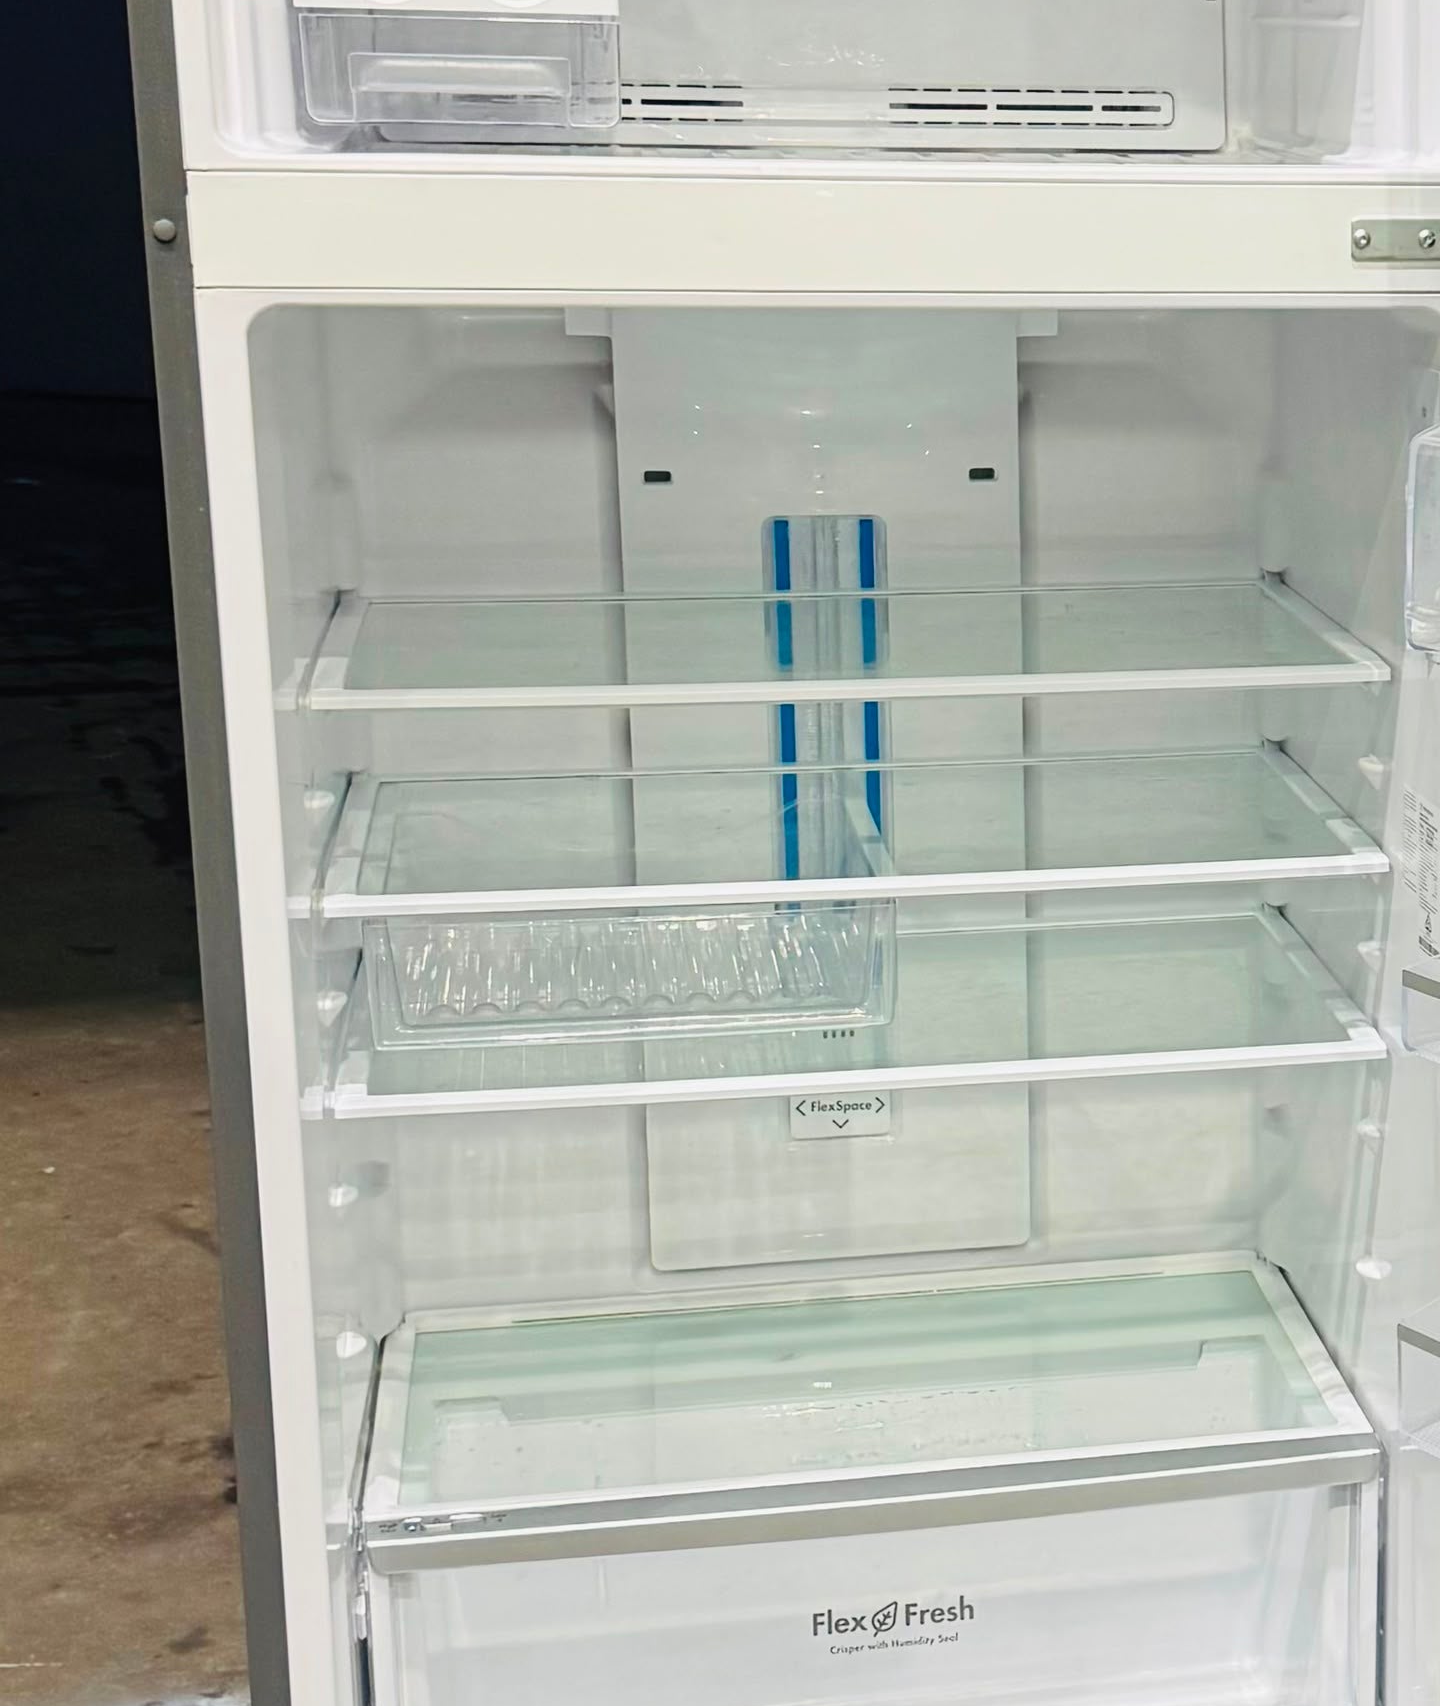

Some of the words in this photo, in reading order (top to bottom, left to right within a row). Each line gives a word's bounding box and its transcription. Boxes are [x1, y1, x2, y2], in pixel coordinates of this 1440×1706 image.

[811, 1100, 873, 1114] FlexSpace
[812, 1608, 869, 1636] Flex
[904, 1595, 975, 1626] Fresh
[830, 1645, 864, 1655] Crisper
[868, 1640, 889, 1650] with
[891, 1635, 935, 1648] Humidity
[938, 1632, 959, 1643] Seal
